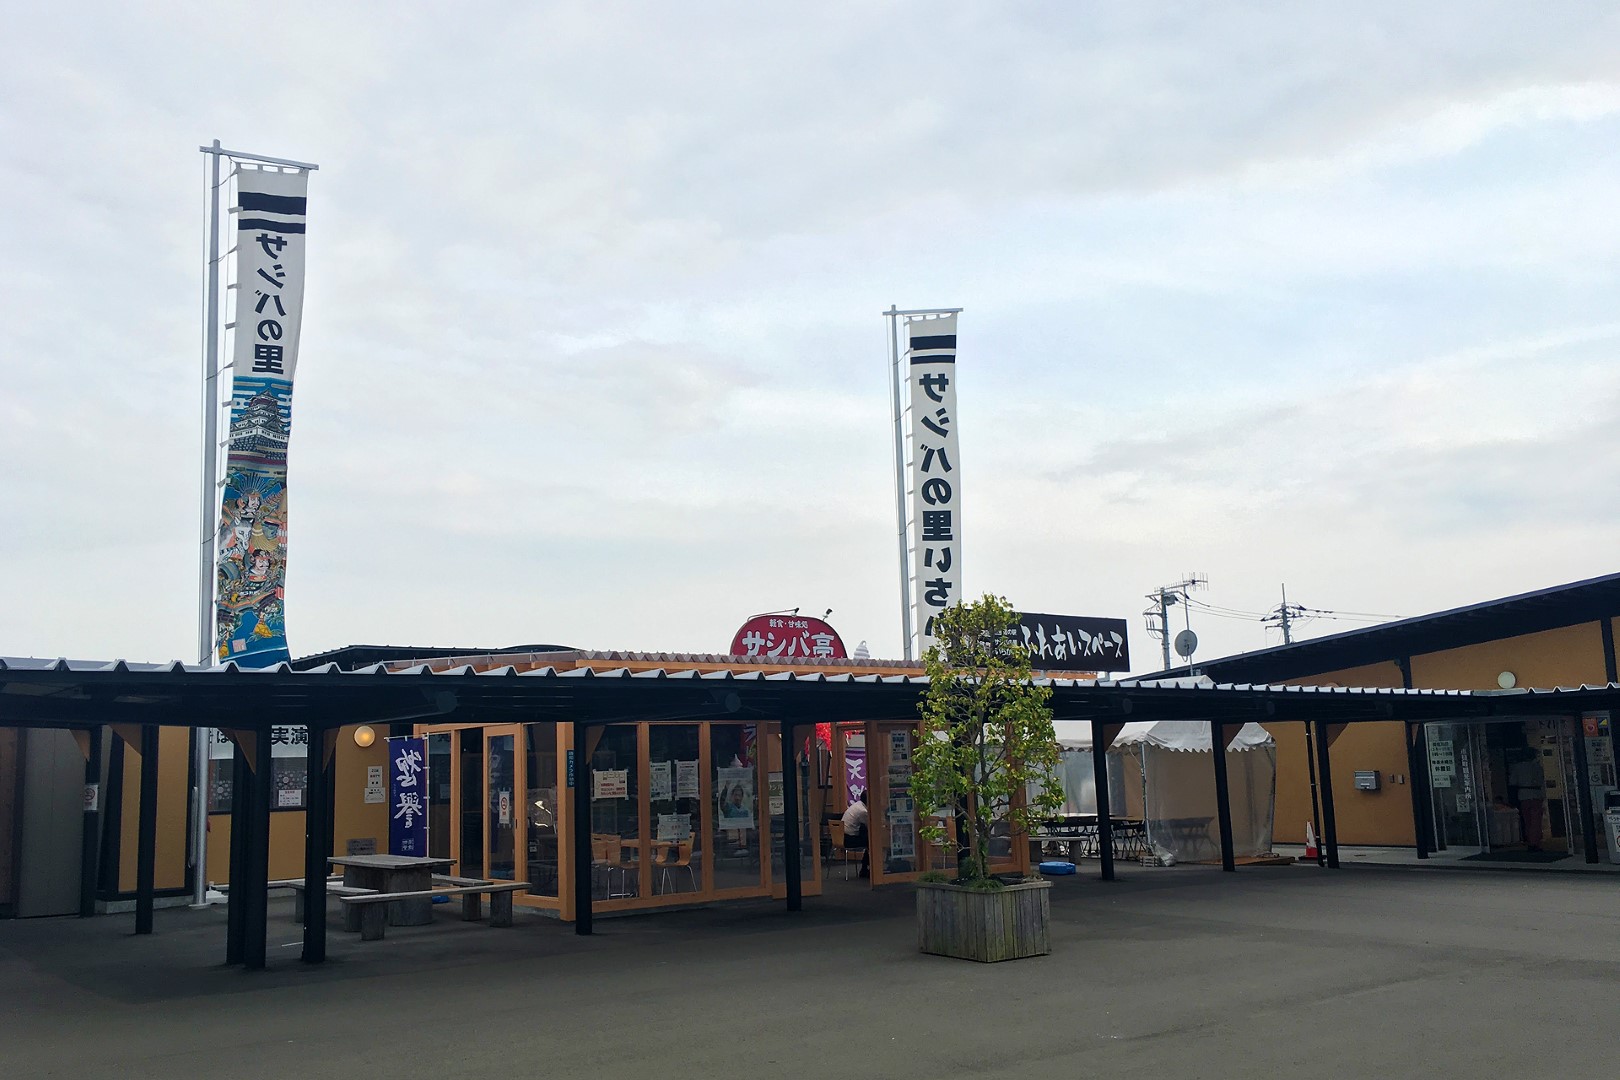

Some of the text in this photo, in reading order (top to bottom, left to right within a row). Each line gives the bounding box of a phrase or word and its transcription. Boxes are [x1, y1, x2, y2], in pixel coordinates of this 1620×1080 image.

[741, 630, 835, 658] サシバ亭
[271, 727, 308, 745] 実演
